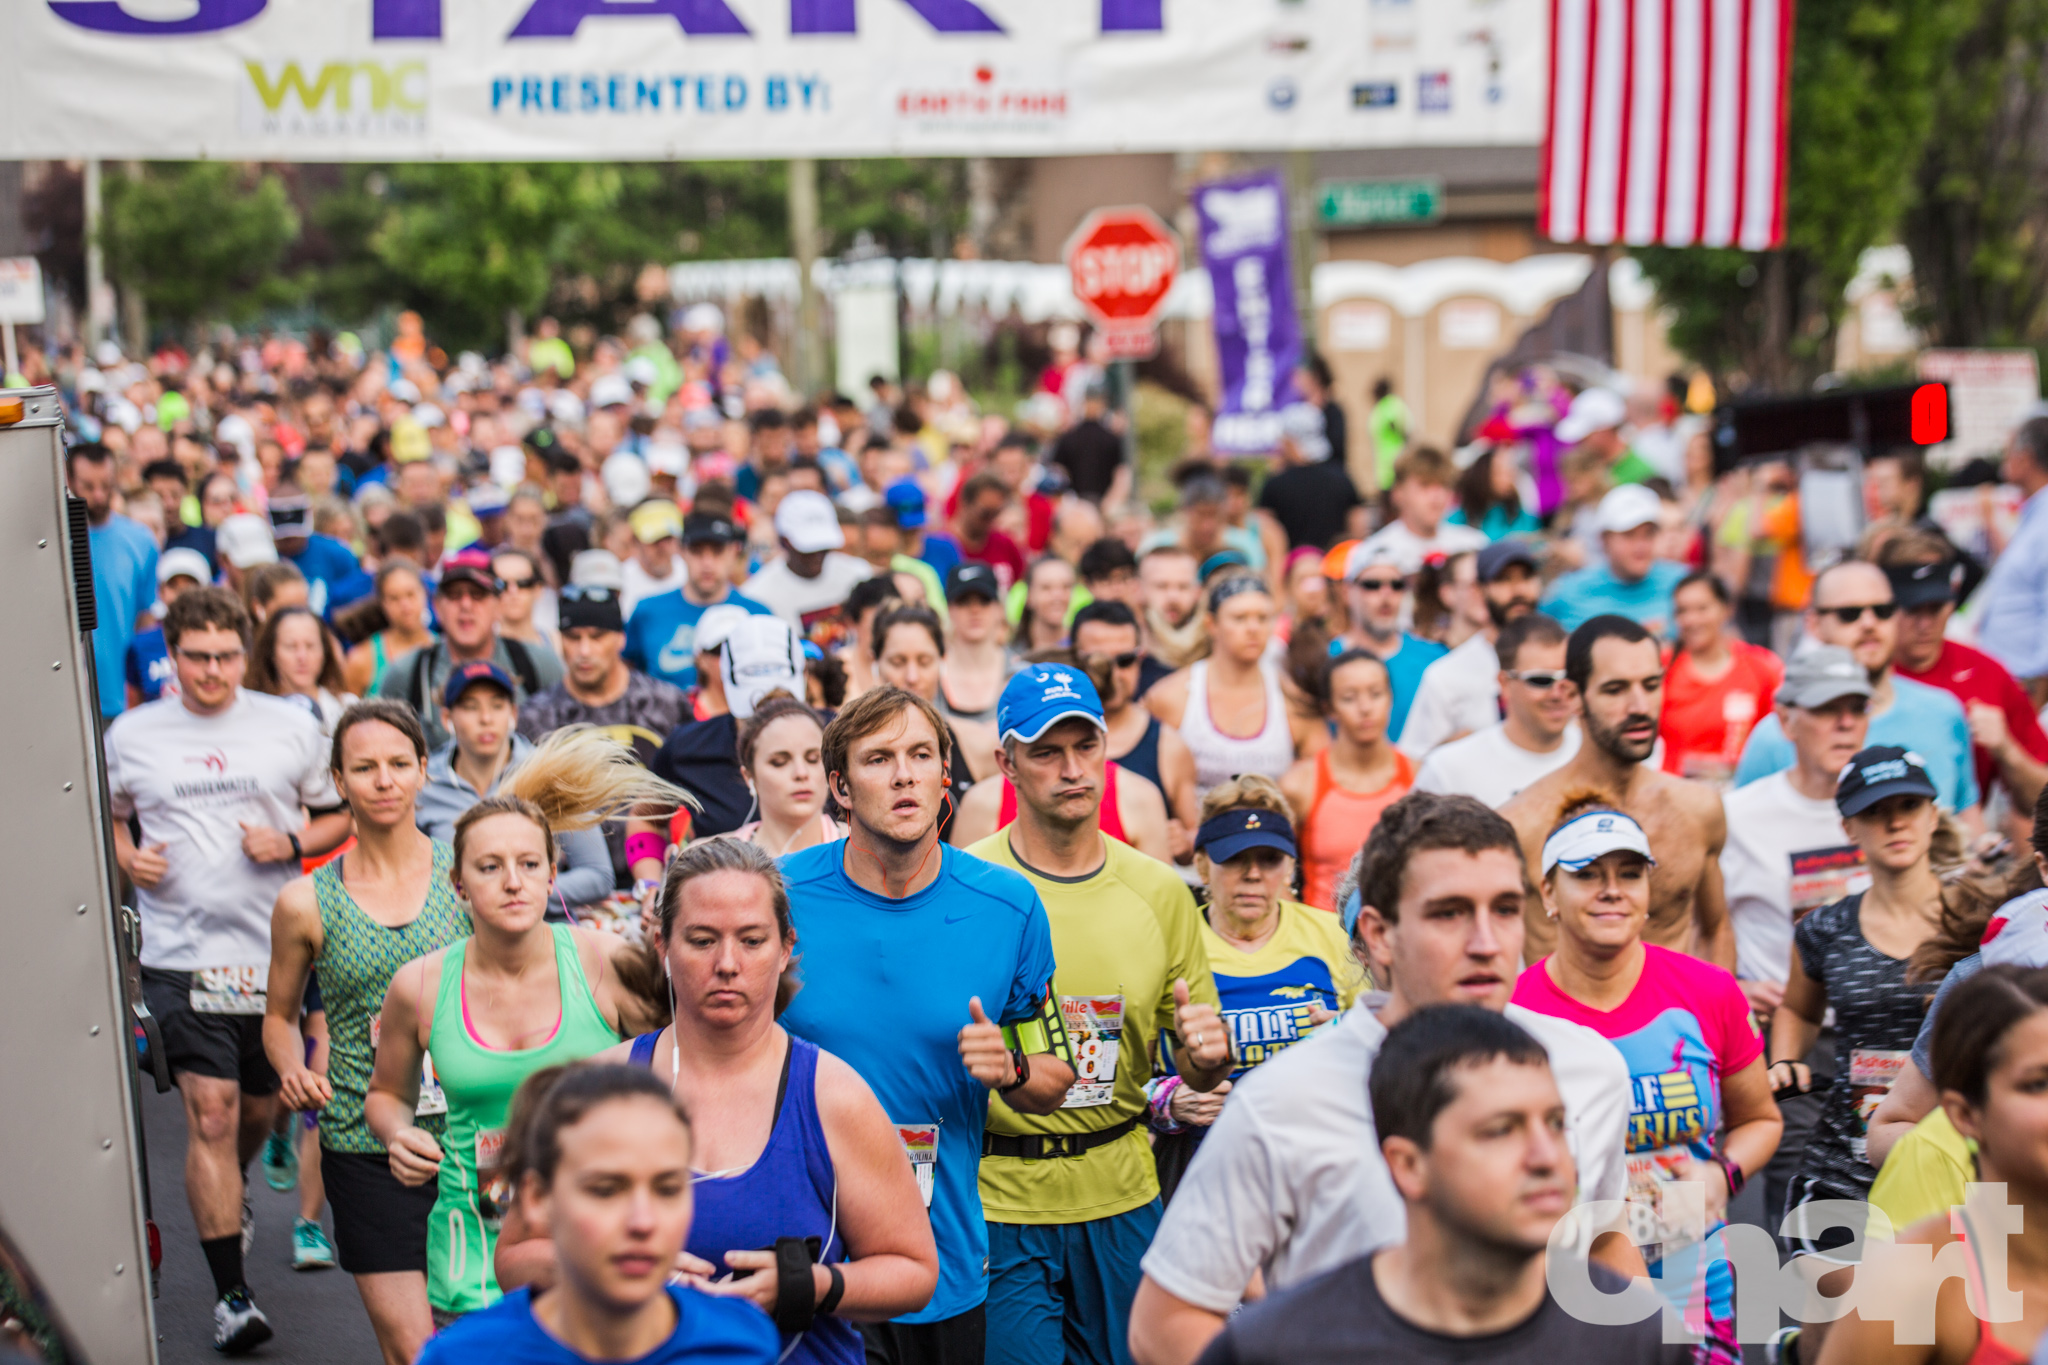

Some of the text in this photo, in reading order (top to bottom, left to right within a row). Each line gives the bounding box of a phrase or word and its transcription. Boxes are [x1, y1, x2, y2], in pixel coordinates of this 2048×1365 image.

[490, 70, 831, 115] PRESENTED BY:
[1074, 243, 1174, 296] STOP
[1061, 1000, 1088, 1013] ville
[1630, 1074, 1660, 1113] LF
[1630, 1108, 1702, 1146] TICS
[908, 1153, 933, 1161] ROLINA
